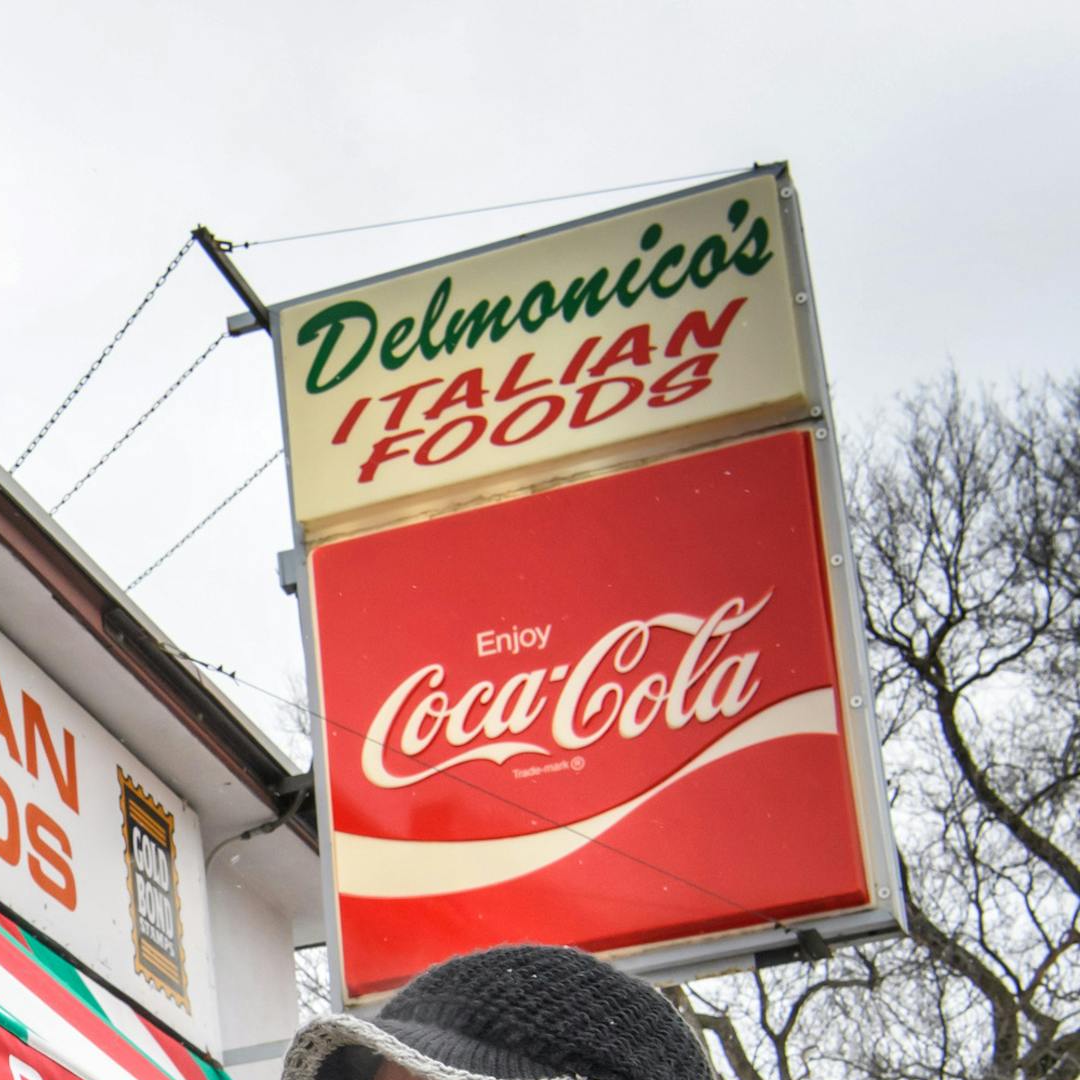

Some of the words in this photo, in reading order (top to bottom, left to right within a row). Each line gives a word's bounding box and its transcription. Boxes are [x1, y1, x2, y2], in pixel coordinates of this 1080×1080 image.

[297, 198, 774, 394] Delmonico's
[331, 297, 749, 445] ITALIAN
[357, 353, 719, 483] FOODS
[361, 585, 775, 789] Coca-Cola
[476, 624, 552, 657] Enjoy
[132, 826, 169, 892] GOLD
[135, 872, 175, 941] BOND
